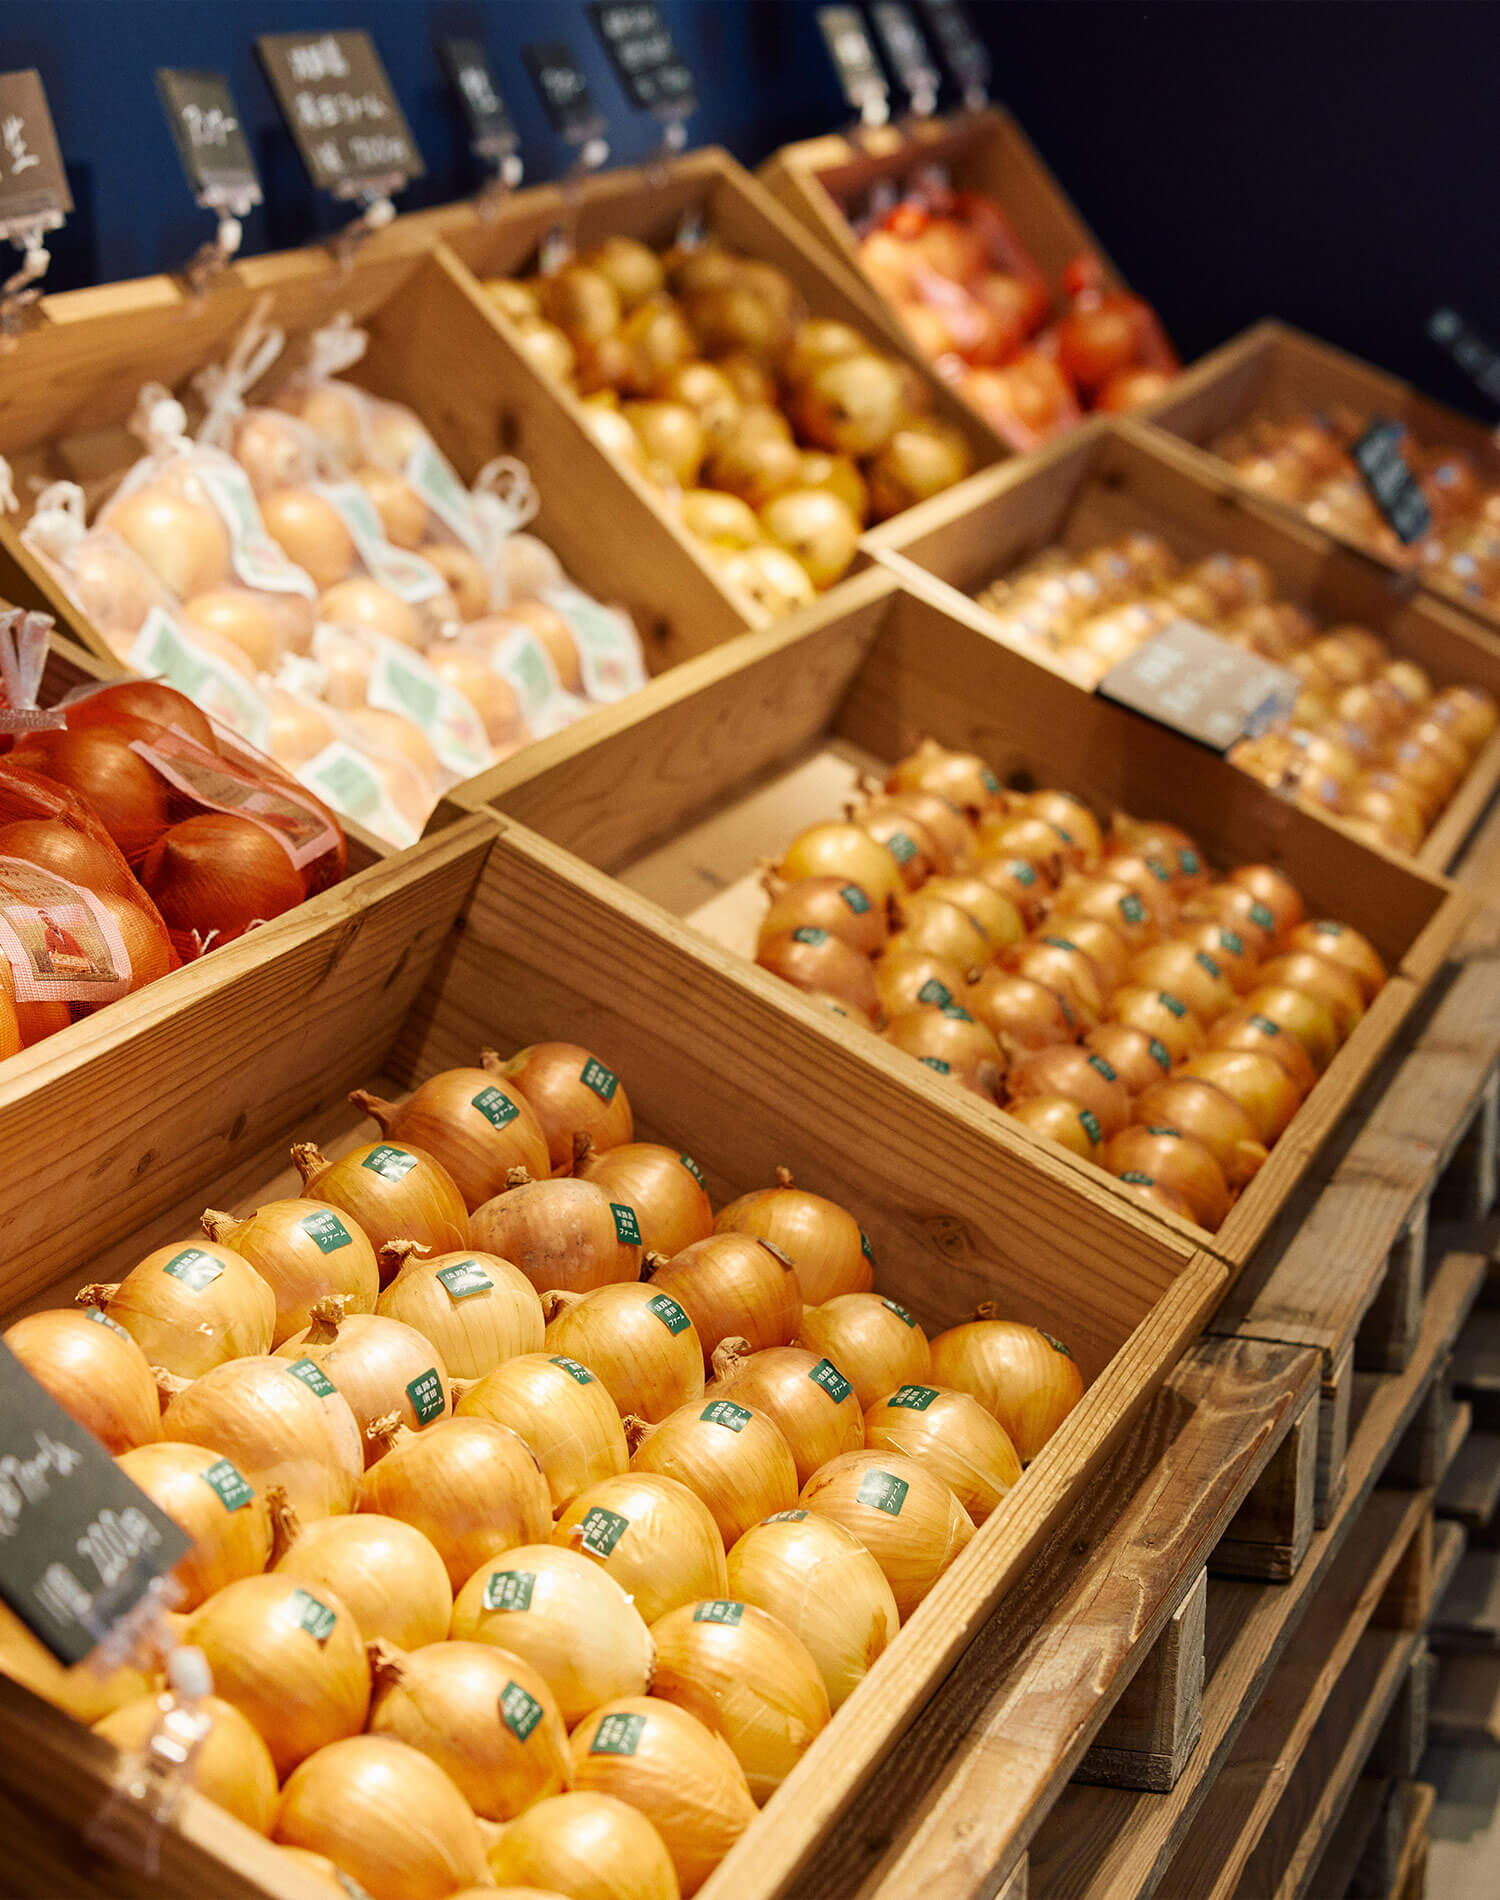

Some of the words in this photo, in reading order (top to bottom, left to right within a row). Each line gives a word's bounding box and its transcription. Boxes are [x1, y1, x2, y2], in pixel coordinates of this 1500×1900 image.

[320, 1230, 347, 1245] ファーム
[668, 1313, 685, 1327] ファーム
[421, 1398, 444, 1417] ファーム
[886, 1481, 902, 1510] ファーム
